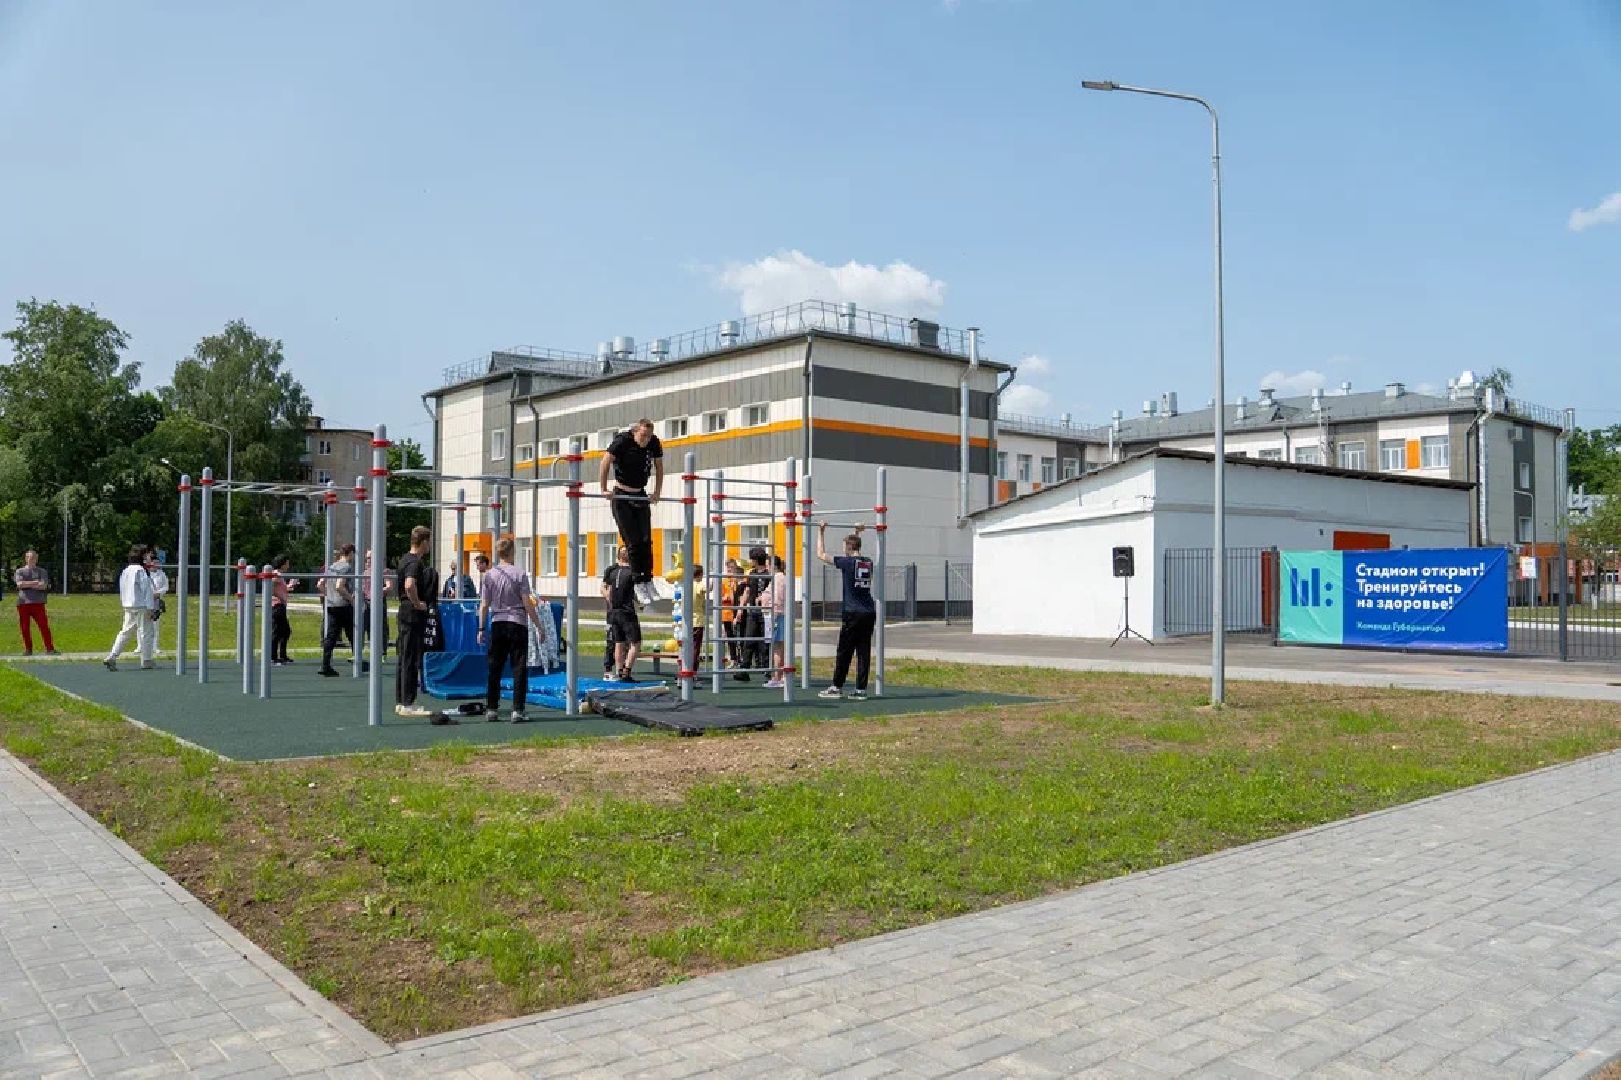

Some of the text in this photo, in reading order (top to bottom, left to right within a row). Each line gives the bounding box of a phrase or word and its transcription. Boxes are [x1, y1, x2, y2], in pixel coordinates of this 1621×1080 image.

[1356, 562, 1485, 579] Стадион открыт!
[1356, 579, 1463, 596] Тренируйтесь
[1356, 596, 1454, 612] на здоровье!
[1357, 621, 1391, 631] Команда
